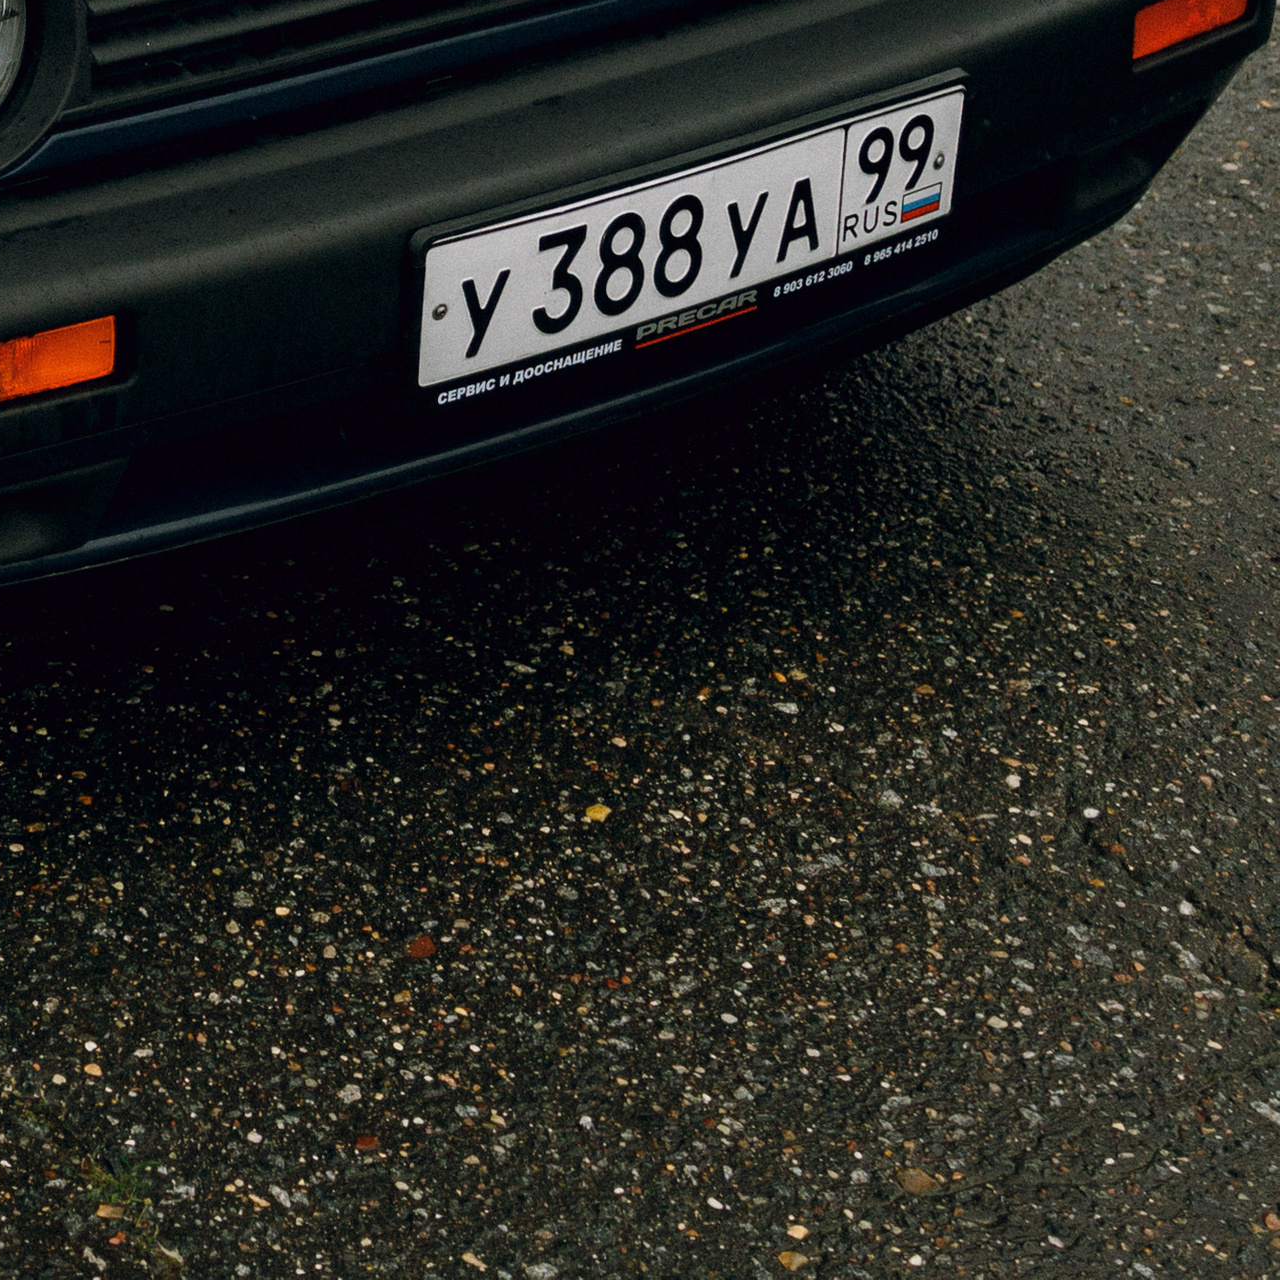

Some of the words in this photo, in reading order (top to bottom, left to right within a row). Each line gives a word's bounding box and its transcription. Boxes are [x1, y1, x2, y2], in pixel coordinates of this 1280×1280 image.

[858, 113, 935, 205] 99
[842, 199, 898, 243] RUS
[863, 255, 871, 266] 8
[872, 247, 892, 263] 965
[893, 240, 913, 256] 414
[914, 229, 939, 248] 2510
[773, 286, 781, 298] 8
[783, 278, 804, 295] 903
[805, 271, 826, 288] 612
[827, 261, 853, 281] 3060
[636, 289, 758, 341] PRECAR
[437, 378, 496, 405] СЕРВИС
[499, 374, 511, 387] И
[513, 339, 623, 385] ДООСНАЩЕНИЕ
